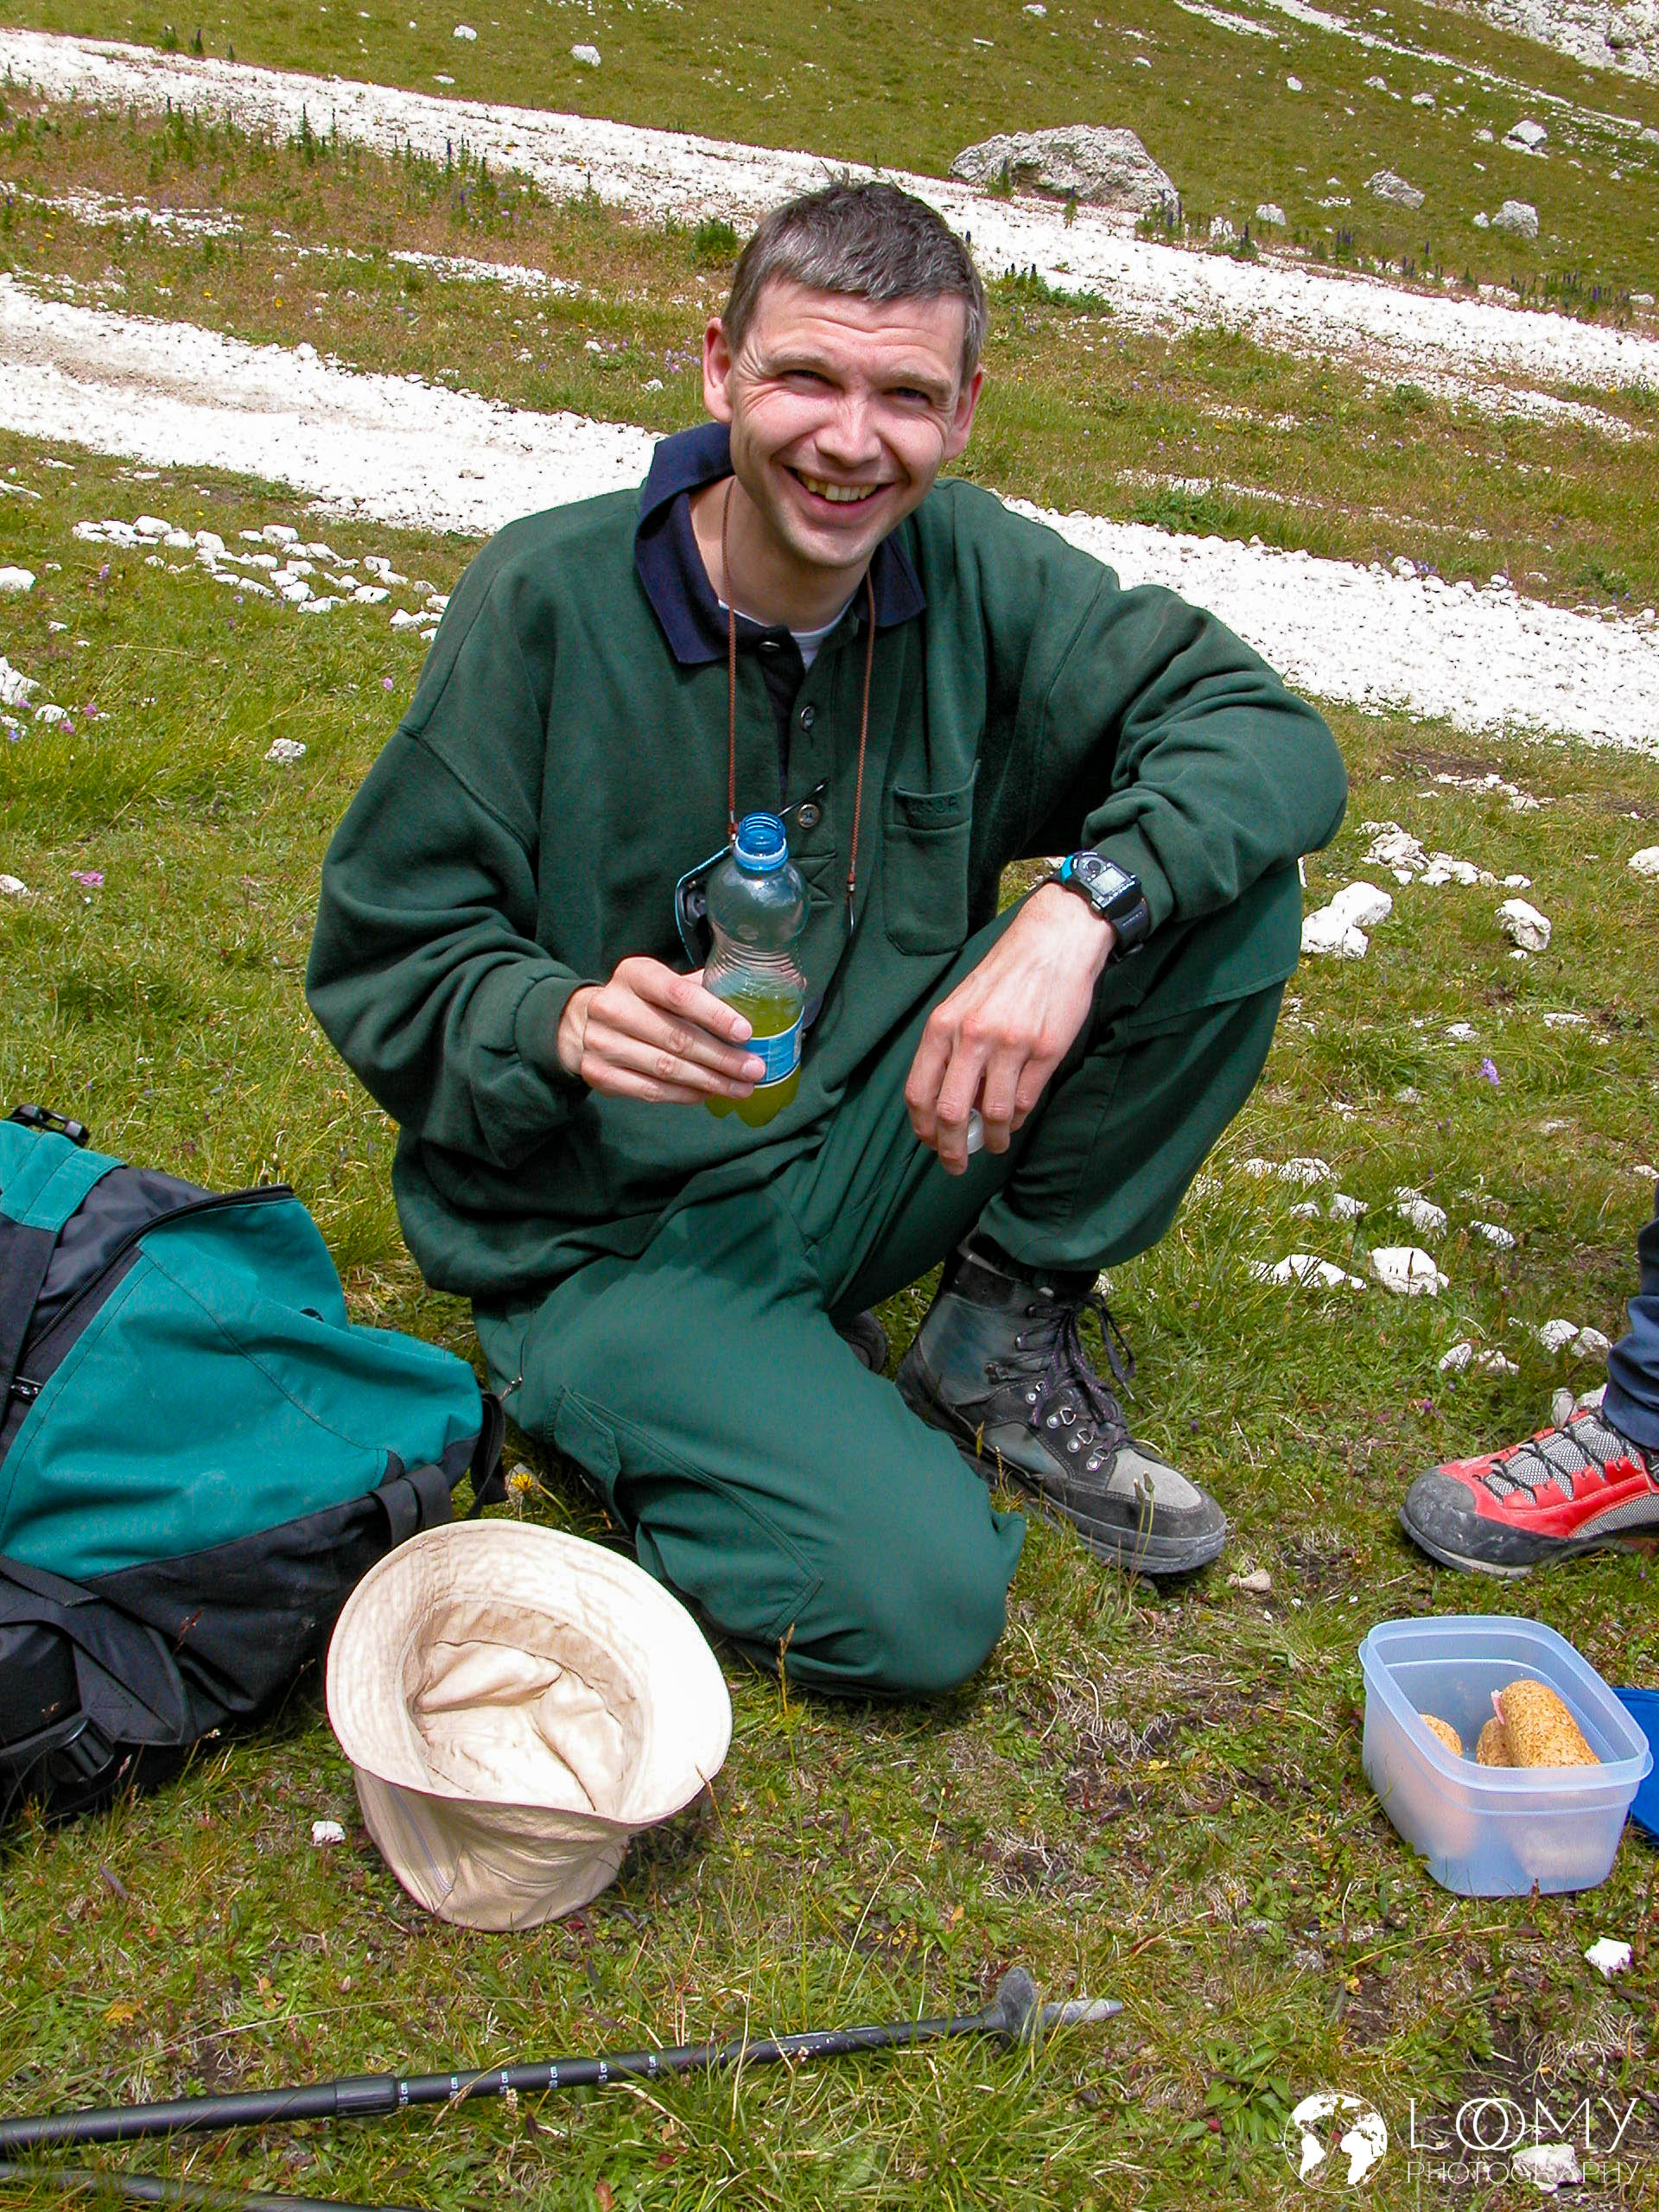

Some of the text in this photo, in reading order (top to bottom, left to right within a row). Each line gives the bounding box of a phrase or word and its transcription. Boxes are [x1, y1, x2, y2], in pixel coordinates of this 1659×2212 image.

[501, 2071, 509, 2083] cm
[550, 2066, 558, 2078] cm
[400, 2082, 409, 2094] cm
[450, 2076, 459, 2088] cm
